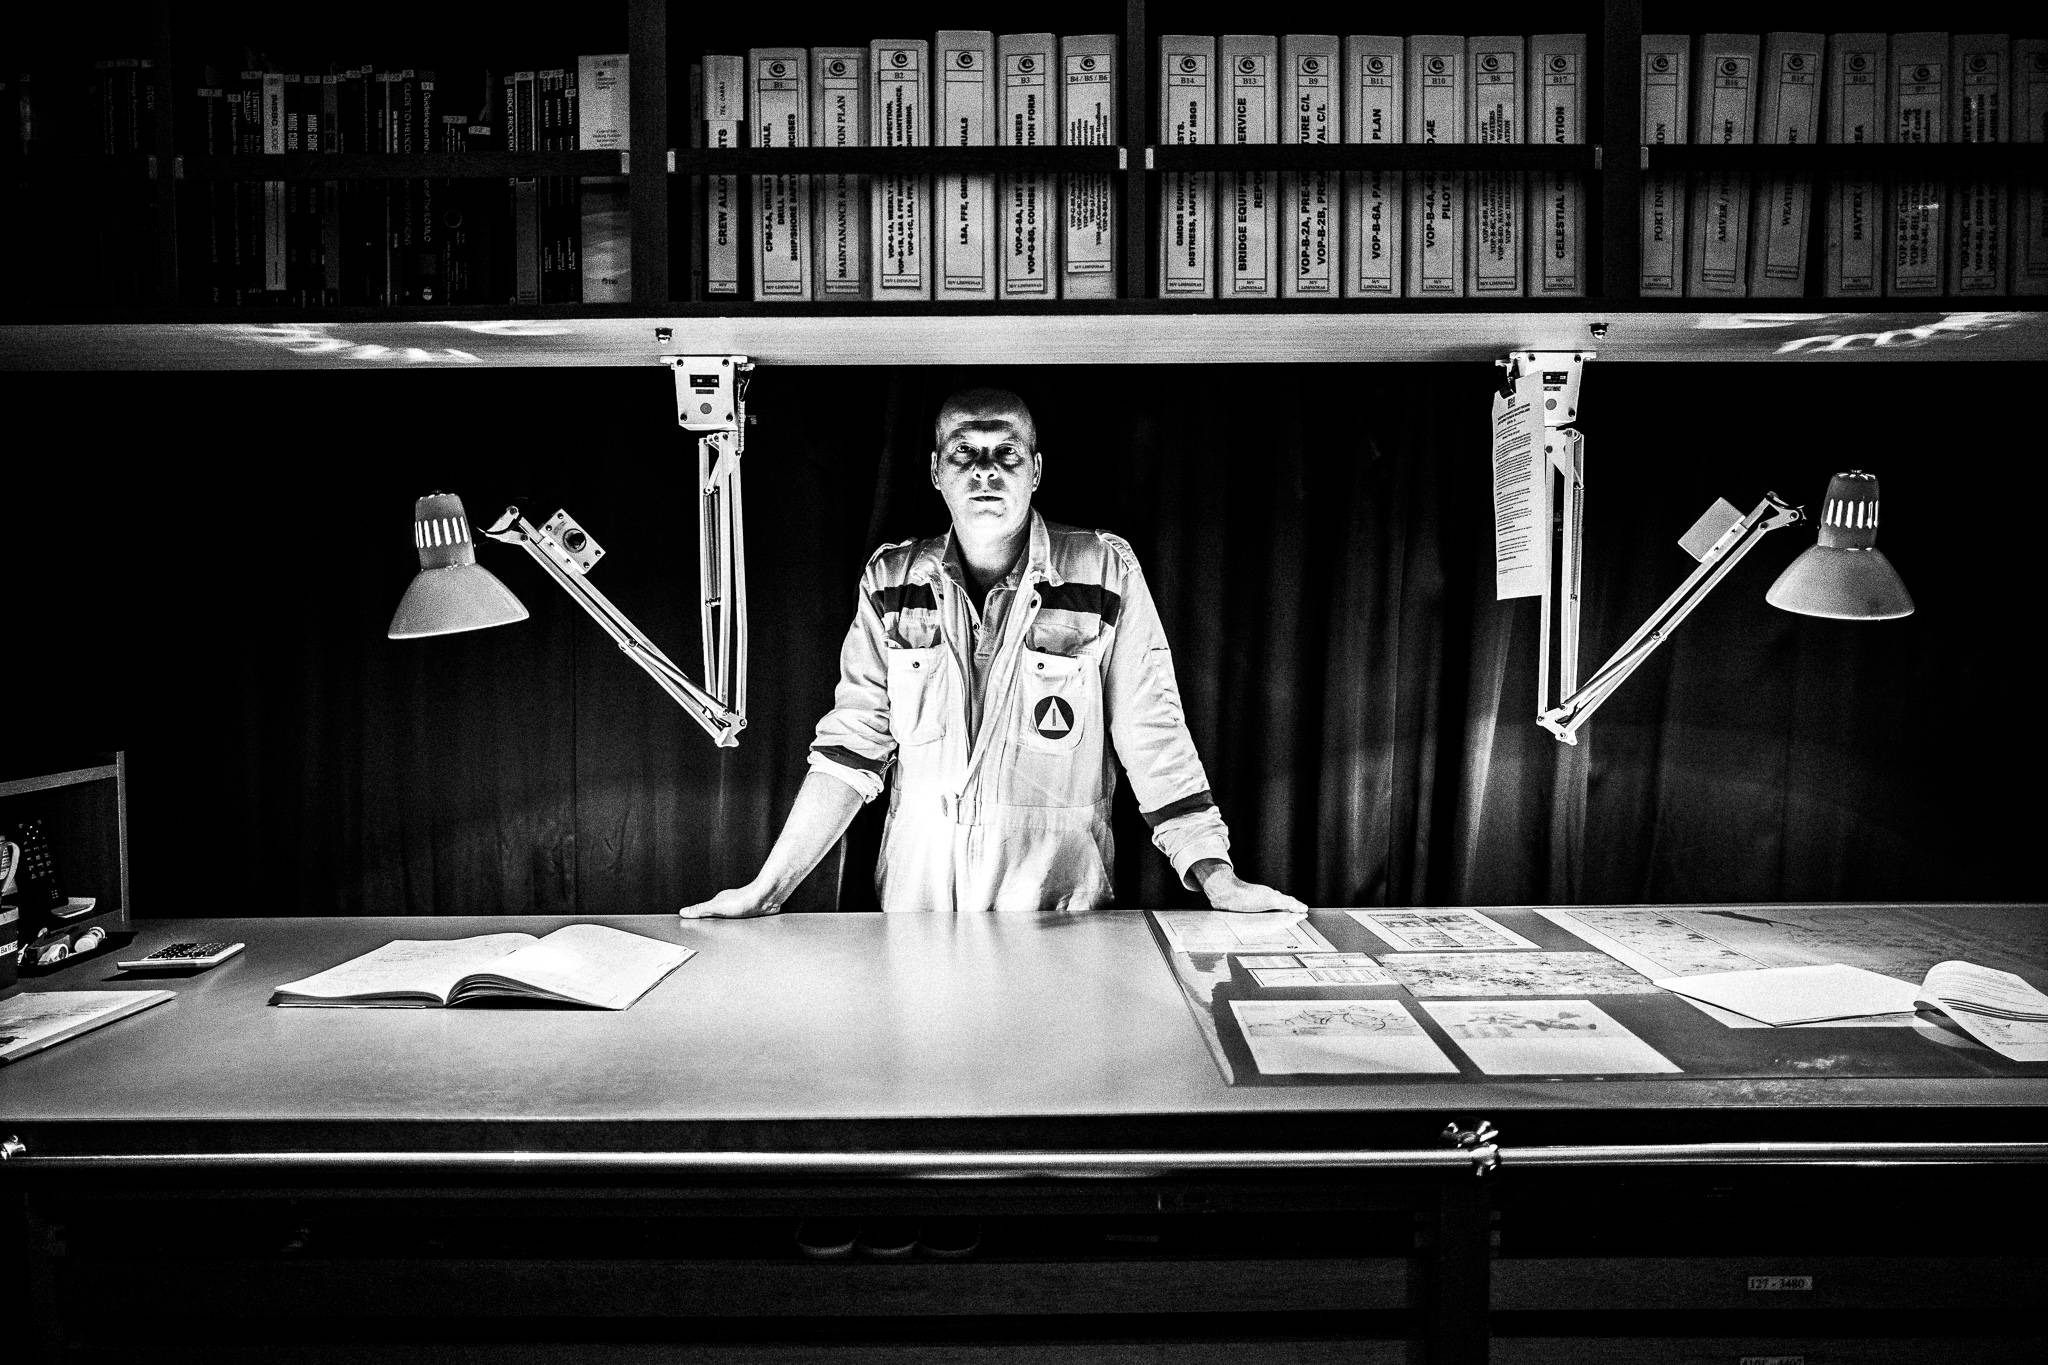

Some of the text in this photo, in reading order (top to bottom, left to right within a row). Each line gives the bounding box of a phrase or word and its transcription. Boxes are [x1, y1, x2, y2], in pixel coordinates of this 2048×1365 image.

[773, 81, 783, 89] B1
[893, 71, 904, 80] B2
[1020, 76, 1030, 84] B3
[1069, 75, 1079, 84] B4
[1084, 74, 1094, 82] B5
[1098, 72, 1108, 81] B6
[1180, 76, 1195, 85] B14
[1242, 76, 1257, 85] B13
[1308, 76, 1318, 85] B9
[1369, 77, 1384, 85] B11
[1431, 77, 1446, 85] B10
[1553, 76, 1568, 84] B17
[506, 88, 514, 114] BRIDGE
[836, 96, 846, 123] PLAN
[895, 85, 904, 142] MAINTENANCE,
[1027, 94, 1036, 121] FORM
[1189, 101, 1197, 128] MSGS
[1901, 109, 1911, 127] Log
[1913, 109, 1921, 131] card
[764, 177, 773, 210] DRILLS
[1015, 188, 1023, 207] LIST
[1188, 177, 1197, 217] SAFETY,
[1301, 94, 1311, 275] VOP-B-2A, C/L
[1317, 104, 1327, 266] VOP-B-2B, C/L
[1371, 109, 1382, 260] VOP-B-6A, PLAN
[776, 198, 785, 225] DRILL
[960, 201, 969, 222] FFE,
[1027, 186, 1036, 225] COURSE
[1441, 185, 1451, 219] PILOT
[717, 213, 728, 246] CREW
[790, 206, 798, 261] SHIP/SHORE
[960, 223, 969, 245] LSA,
[1176, 213, 1184, 247] GMDSS
[1555, 195, 1565, 259] CELESTIAL
[1654, 211, 1664, 241] PORT
[1717, 204, 1728, 243] AMVER
[837, 201, 847, 278] MAINTANANCE
[1188, 218, 1197, 268] DISTRESS,
[1237, 226, 1247, 271] BRIDGE
[1750, 1278, 1769, 1289] 127
